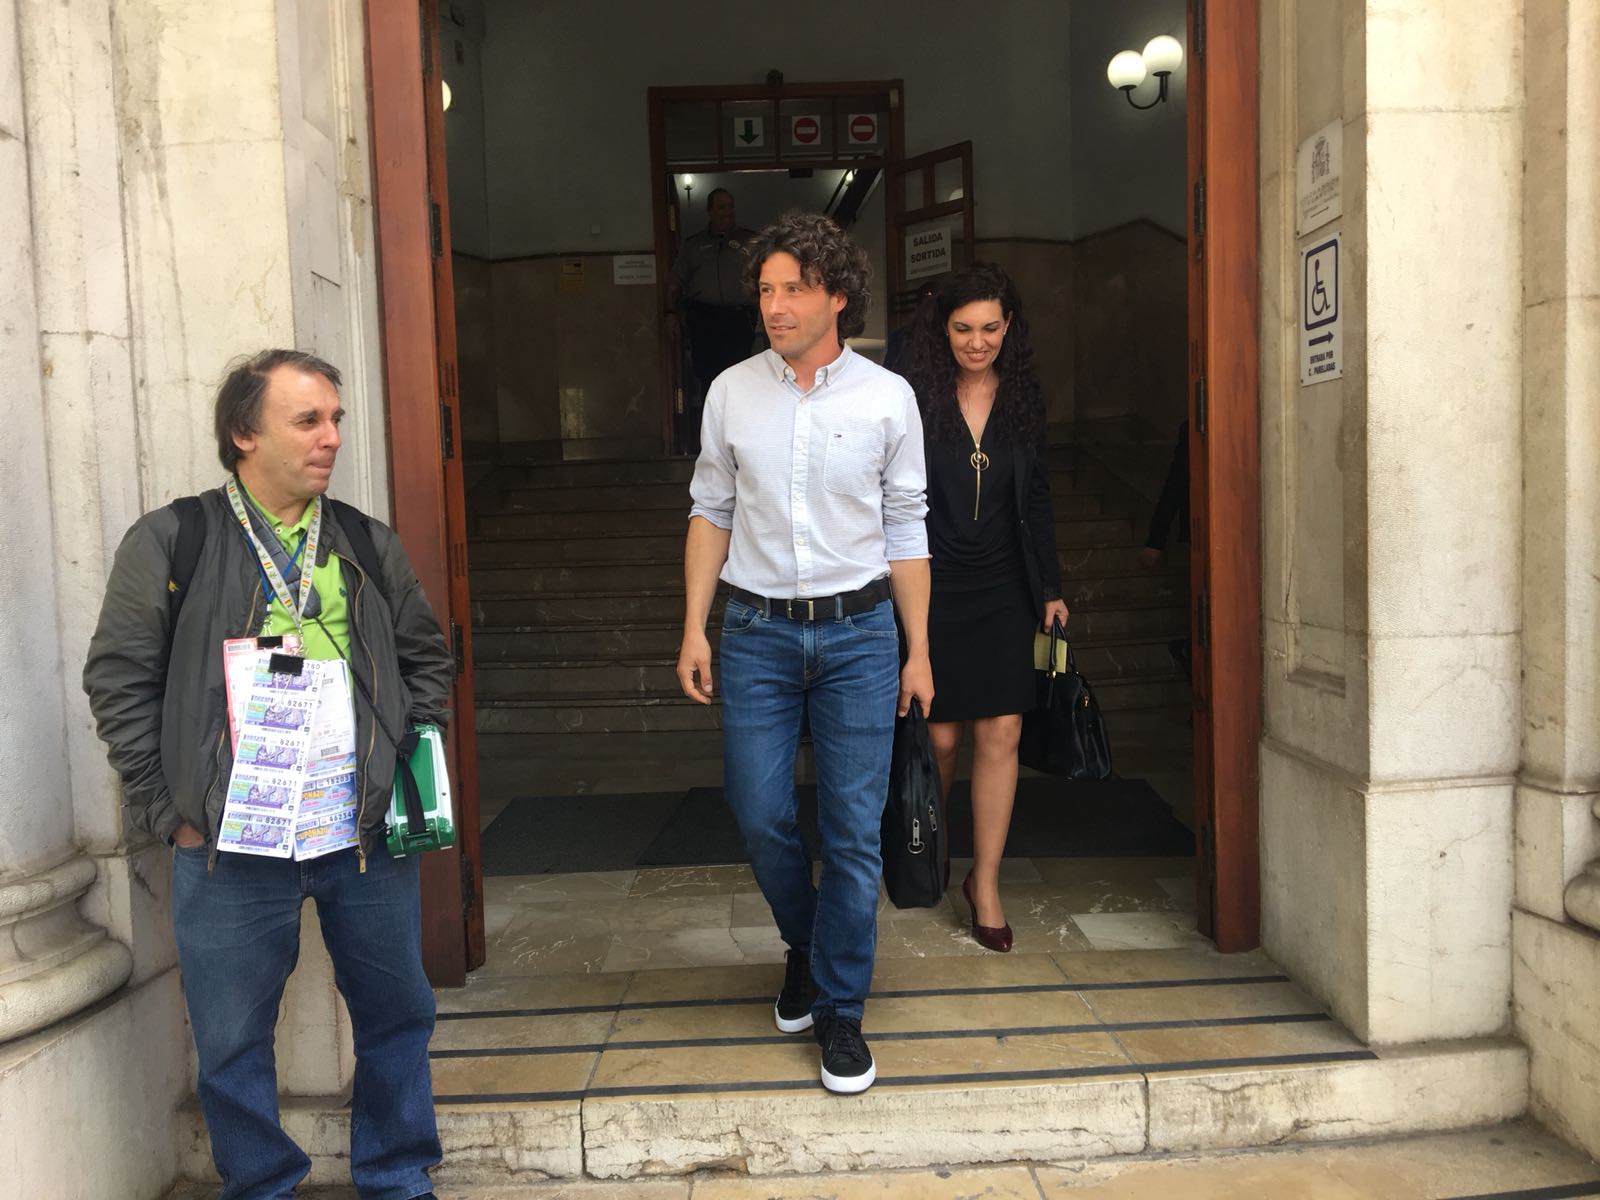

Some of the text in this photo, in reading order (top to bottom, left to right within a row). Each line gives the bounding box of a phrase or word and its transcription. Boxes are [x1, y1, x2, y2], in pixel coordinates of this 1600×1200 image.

[913, 232, 943, 247] SALIDA
[911, 247, 946, 264] SORTIDA
[1309, 350, 1334, 364] ENTRADA POR
[287, 700, 313, 709] 82671
[280, 739, 305, 748] 82671
[272, 778, 297, 787] 82671
[326, 774, 350, 786] 15203
[265, 816, 291, 826] 82671
[329, 811, 352, 822] 46234
[296, 827, 329, 840] CUPONAZO
